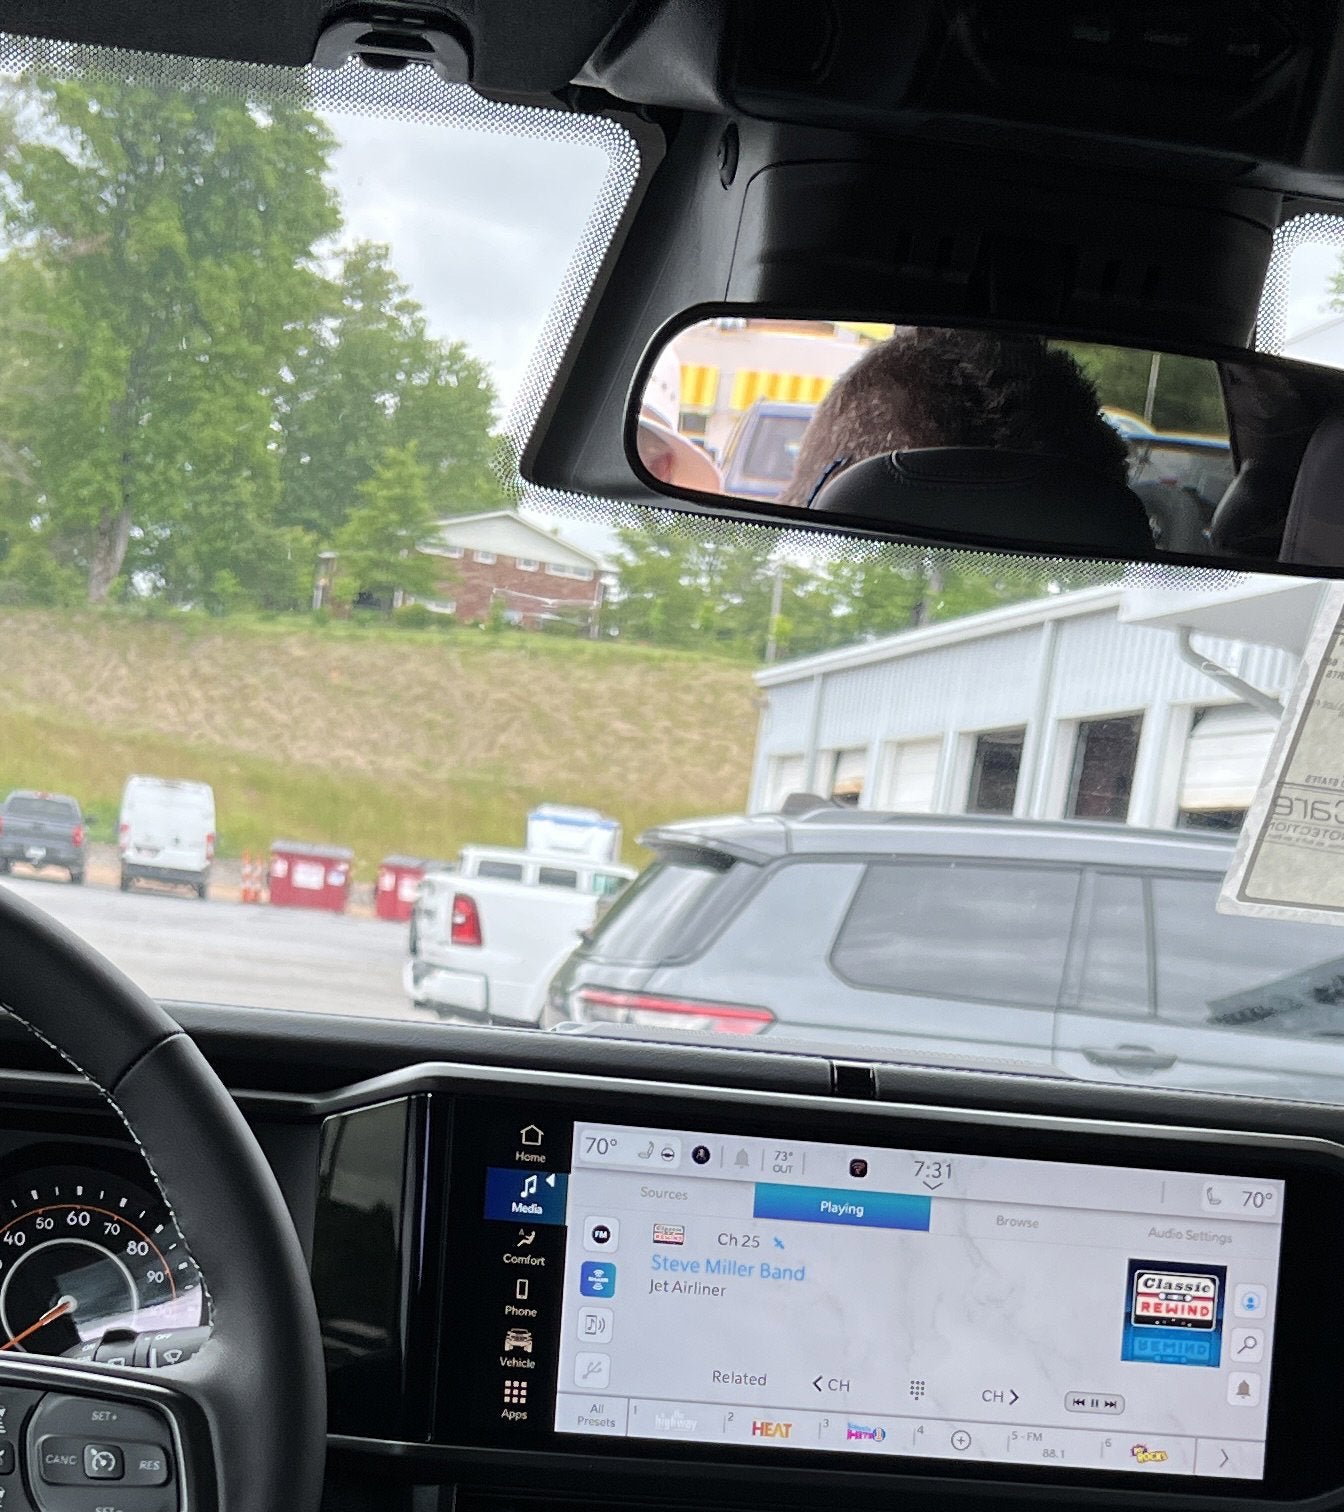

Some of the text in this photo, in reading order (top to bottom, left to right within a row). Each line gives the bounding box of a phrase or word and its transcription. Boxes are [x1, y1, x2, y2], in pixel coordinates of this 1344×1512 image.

[585, 1136, 618, 1156] 70°
[515, 1150, 547, 1163] Home
[774, 1150, 794, 1162] 73°
[772, 1163, 794, 1174] OUT
[913, 1160, 953, 1180] 7:31
[640, 1185, 689, 1202] Sources
[1241, 1190, 1274, 1209] 70°
[511, 1202, 543, 1215] Media
[820, 1200, 865, 1218] Playing
[35, 1217, 55, 1231] 50
[66, 1211, 92, 1227] 60
[996, 1215, 1040, 1230] Browse
[103, 1222, 122, 1236] 70
[594, 1230, 609, 1240] FM
[1147, 1226, 1233, 1245] Audio Settings
[2, 1231, 27, 1248] 40
[717, 1232, 761, 1249] Ch 25
[126, 1240, 150, 1257] 80
[503, 1253, 546, 1267] Comfort
[651, 1253, 806, 1282] Steve Miller Band
[145, 1270, 165, 1284] 90
[648, 1279, 728, 1297] Jet Airliner
[1142, 1277, 1212, 1294] Classic
[505, 1305, 538, 1318] Phone
[1141, 1301, 1210, 1318] REWIND
[499, 1356, 536, 1370] Vehicle
[712, 1369, 768, 1387] Related
[827, 1378, 851, 1393] CH
[981, 1389, 1005, 1404] CH
[501, 1408, 528, 1422] Apps
[590, 1403, 605, 1415] All
[577, 1415, 616, 1429] Presets
[751, 1420, 793, 1438] HEAT
[1027, 1432, 1043, 1442] FM
[45, 1453, 78, 1466] CANC
[1042, 1448, 1066, 1459] 88.1
[138, 1459, 161, 1471] RES
